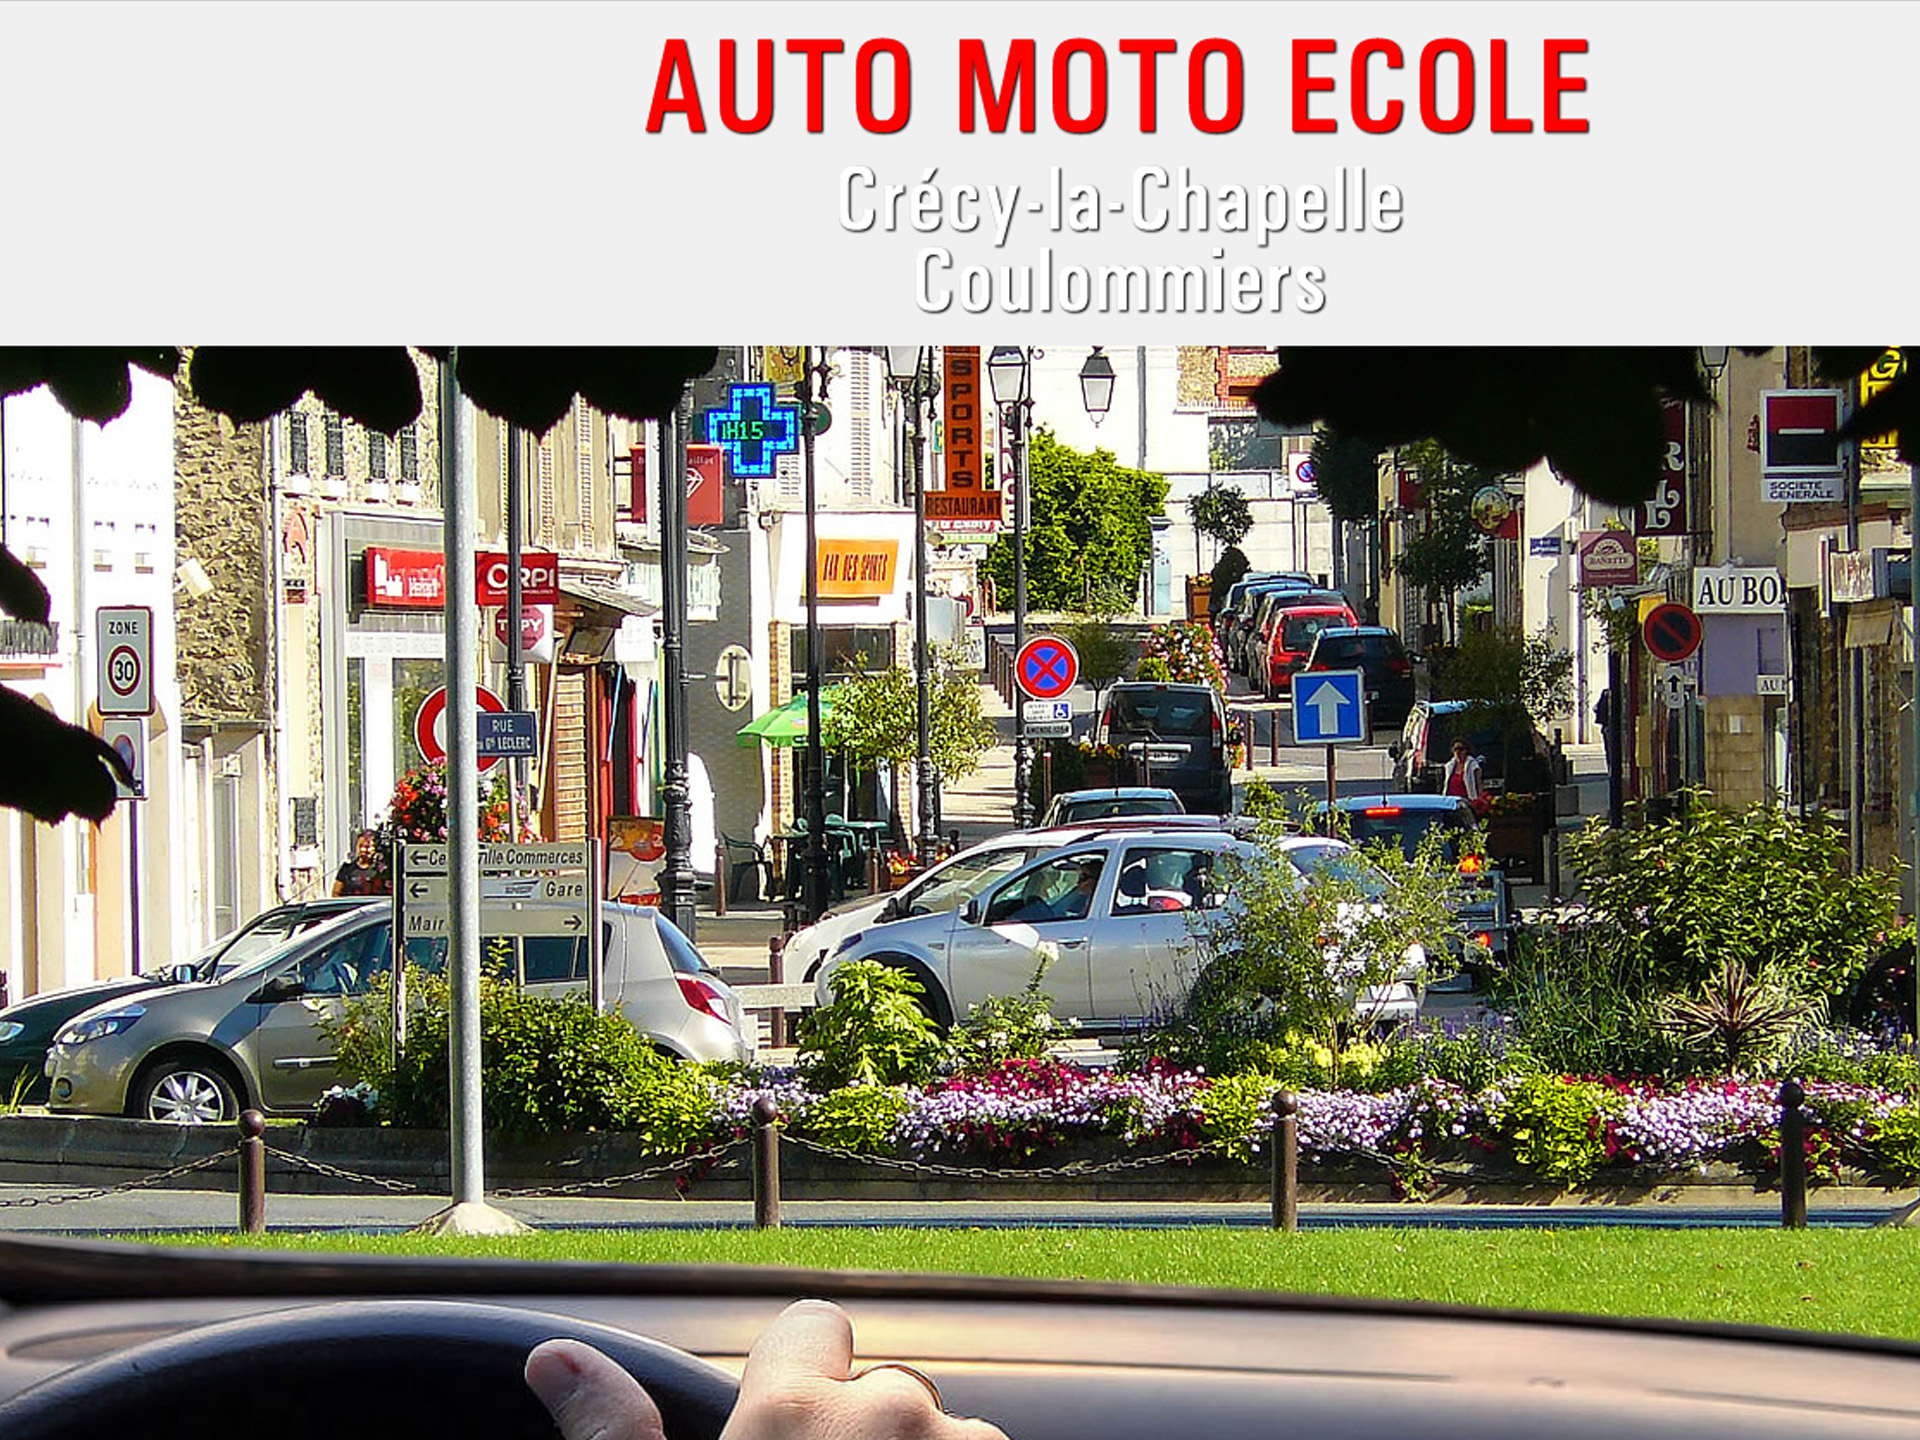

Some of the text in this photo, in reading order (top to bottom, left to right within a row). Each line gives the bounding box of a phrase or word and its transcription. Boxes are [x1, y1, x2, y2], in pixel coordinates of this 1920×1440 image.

[951, 359, 974, 488] SPORTS
[1770, 490, 1835, 499] GENERALE
[926, 497, 1001, 516] RESTAURANT
[1698, 577, 1736, 606] AU
[109, 622, 138, 634] ZONE
[497, 618, 543, 631] TPY
[114, 661, 134, 681] 30
[491, 719, 515, 733] RUE
[497, 737, 531, 750] LECLERC
[506, 848, 583, 866] Commerces
[546, 880, 583, 898] Gare
[408, 915, 445, 932] Mair
